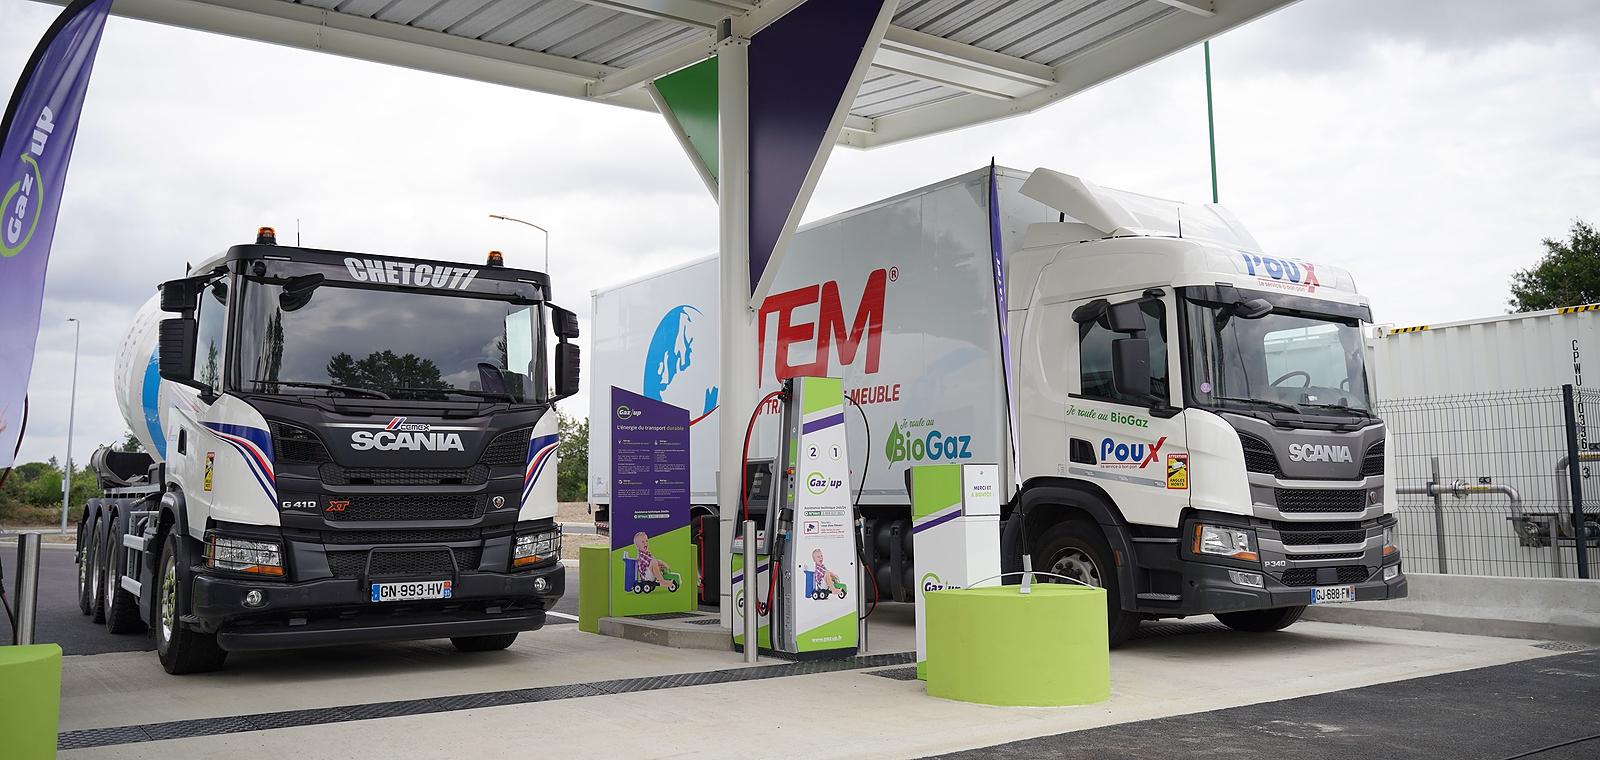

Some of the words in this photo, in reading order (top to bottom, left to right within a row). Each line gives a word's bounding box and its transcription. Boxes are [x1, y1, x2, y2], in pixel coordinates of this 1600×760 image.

[7, 173, 34, 243] Gaz
[31, 105, 55, 157] up
[343, 257, 479, 290] CHETCUTI
[849, 383, 901, 406] MEUBLE
[1066, 405, 1076, 415] Je
[1077, 408, 1097, 419] roule
[1098, 413, 1108, 421] au
[1110, 412, 1149, 428] BioGaz
[350, 430, 465, 452] SCANIA
[810, 447, 817, 457] 2
[892, 430, 972, 461] BioGaz
[1288, 443, 1353, 463] SCANIA
[809, 478, 827, 487] Gaz
[829, 479, 842, 489] up
[380, 582, 443, 598] GN-993-HV
